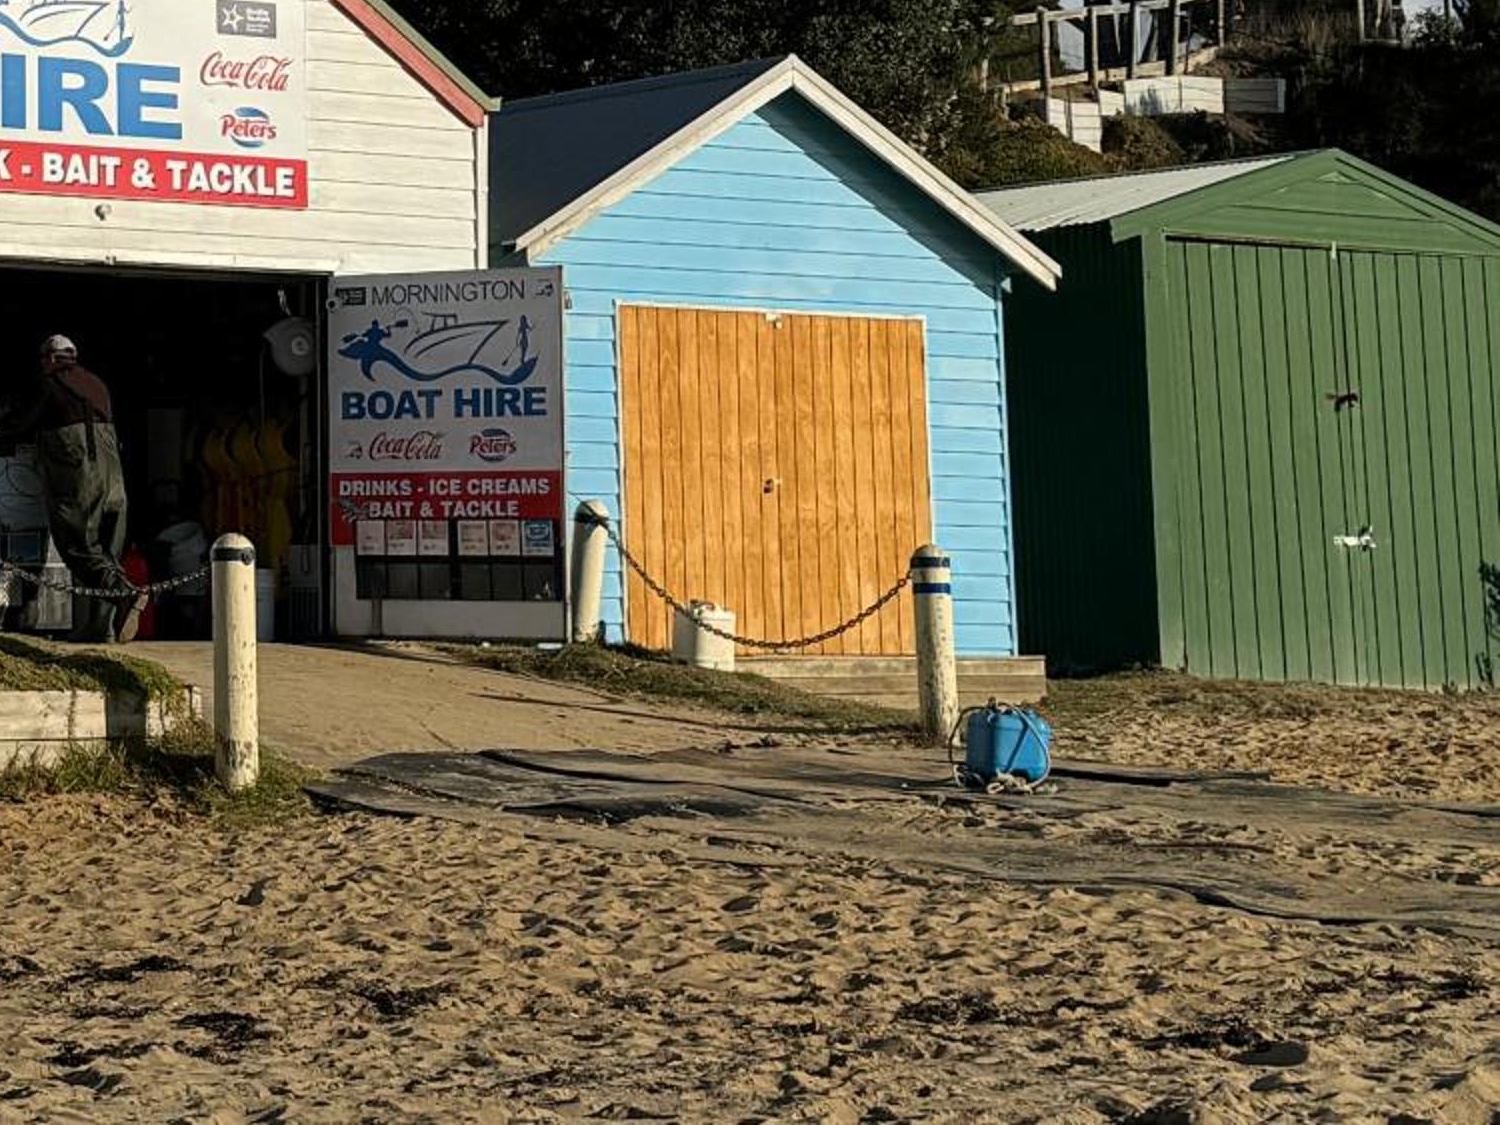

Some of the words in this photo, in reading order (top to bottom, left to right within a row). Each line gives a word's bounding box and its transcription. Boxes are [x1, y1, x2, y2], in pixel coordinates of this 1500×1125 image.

[219, 114, 277, 140] Peters
[42, 152, 121, 186] BAIT
[131, 158, 156, 189] &
[166, 159, 295, 197] TACKLE
[371, 279, 525, 306] MORNINGTON
[341, 389, 443, 420] BOAT
[454, 386, 548, 418] HIRE
[339, 479, 412, 496] DRINKS
[429, 478, 462, 496] ICE
[467, 478, 550, 495] CREAMS
[369, 501, 414, 518] BAIT
[419, 501, 434, 518] &
[442, 500, 519, 517] TACKLE
